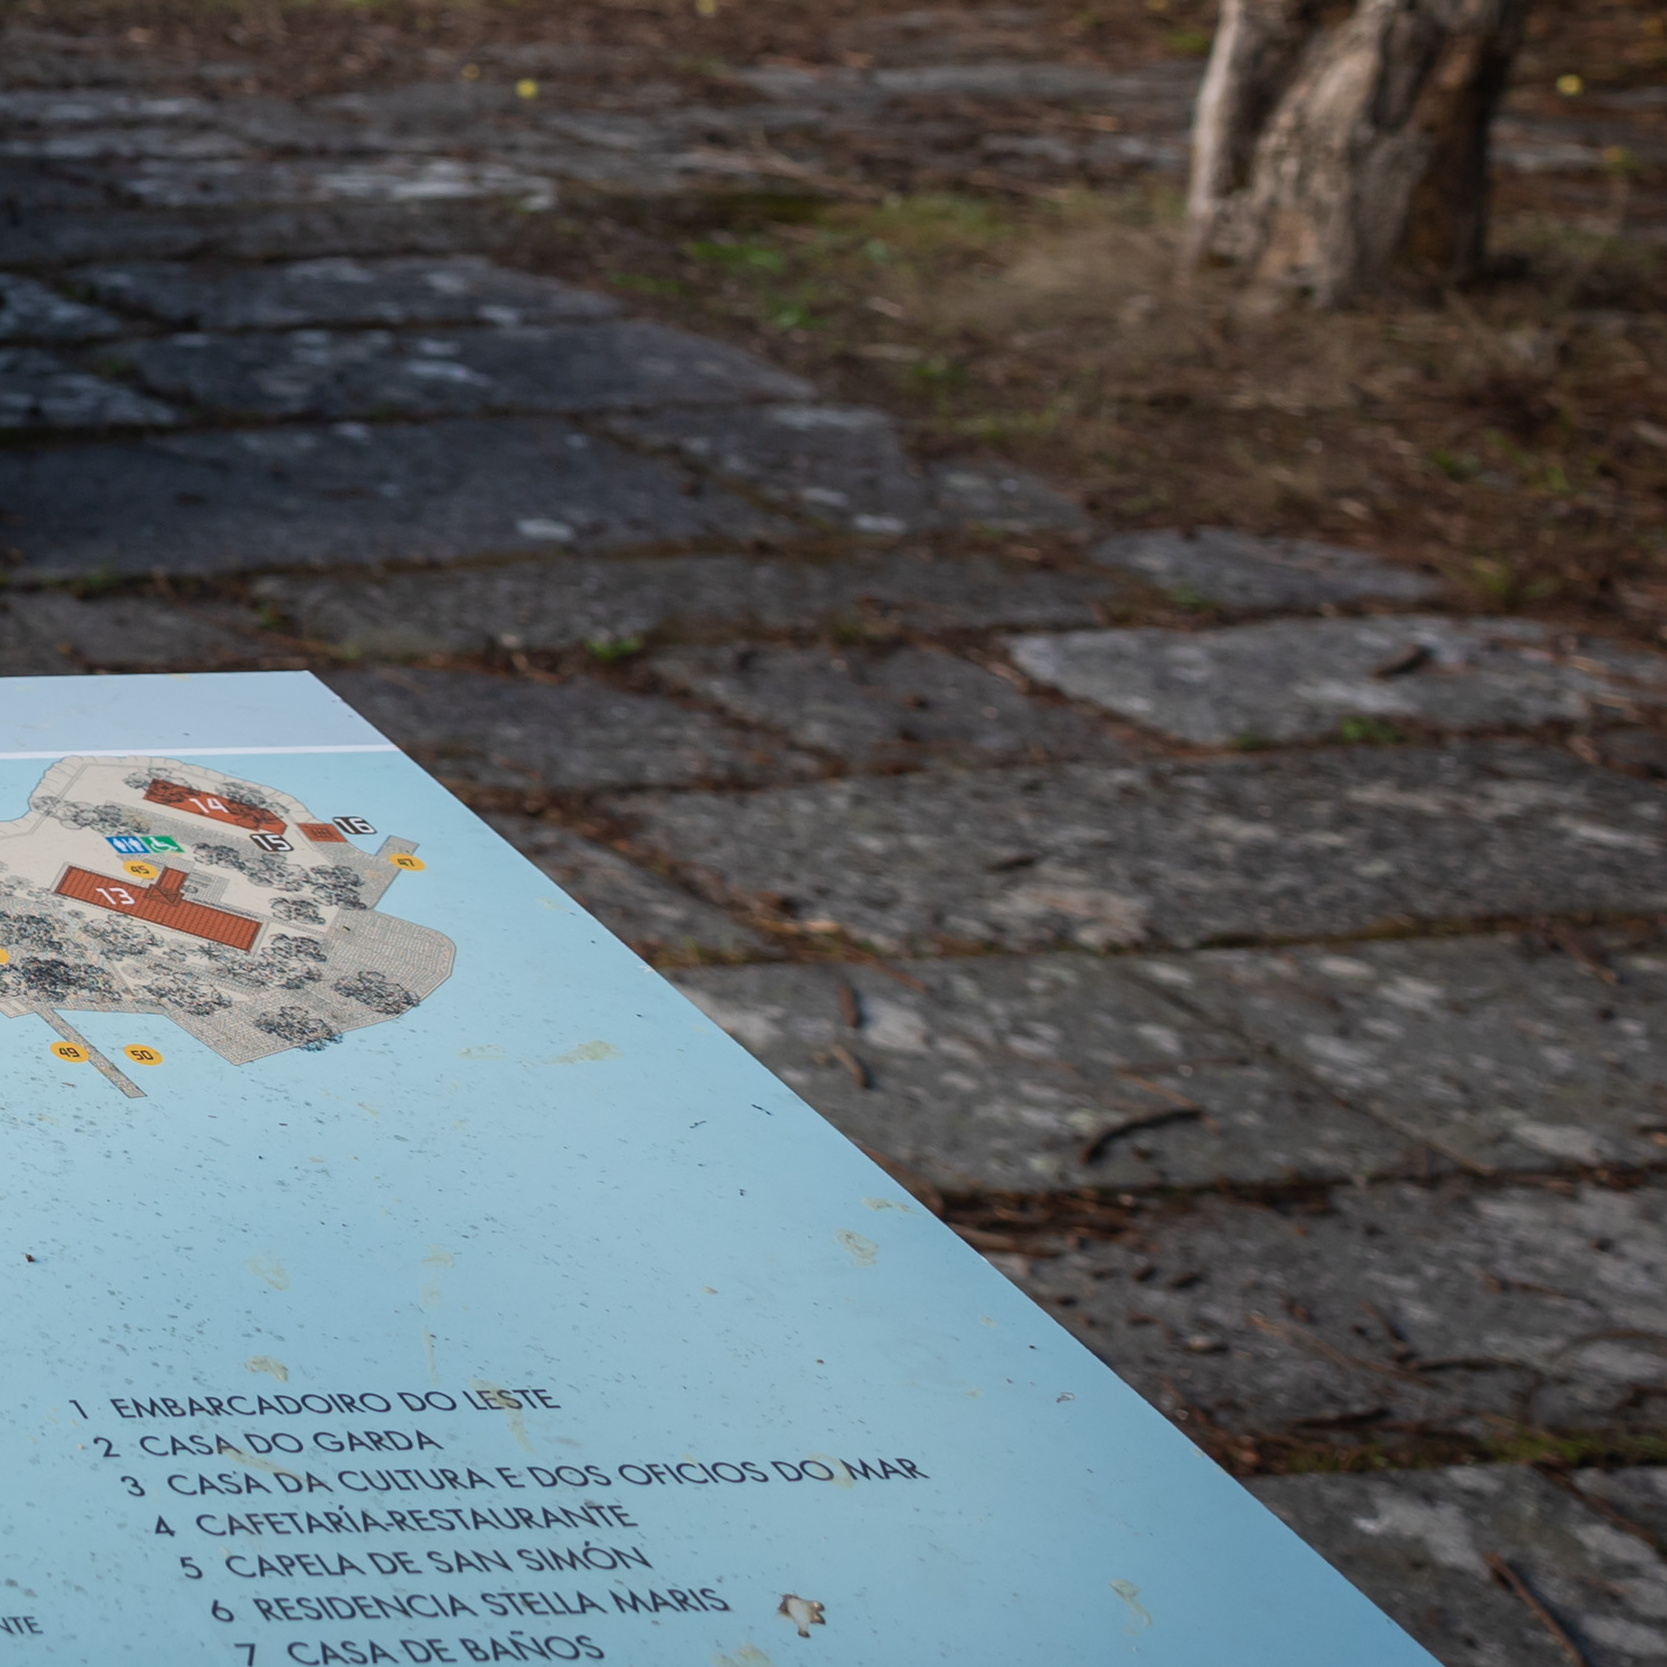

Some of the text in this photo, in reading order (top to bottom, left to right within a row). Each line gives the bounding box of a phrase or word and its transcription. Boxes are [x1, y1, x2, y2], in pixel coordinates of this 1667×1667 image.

[189, 798, 230, 815] 14
[333, 817, 373, 834] 16
[255, 835, 293, 852] 15
[130, 864, 151, 875] 45
[396, 858, 417, 867] 47
[96, 887, 135, 905] 13
[59, 1046, 81, 1058] 49
[132, 1049, 154, 1061] 50
[68, 1389, 561, 1419] 1 EMBARCADOIRO DO LESTE
[93, 1430, 444, 1457] 2 CASA DO GARDA
[120, 1458, 930, 1496] 3 CASA DA CULTURA E DOS OFICIOS DO MAR
[155, 1504, 638, 1537] 4 CAFETARÍA-RESTAURANTE
[179, 1541, 653, 1579] 5 CAPELA DE SAN SIMÓN
[211, 1587, 730, 1622] 6 RESIDENCIA STELLA MARIS
[234, 1630, 604, 1666] 7 CASA DE BAÑOS
